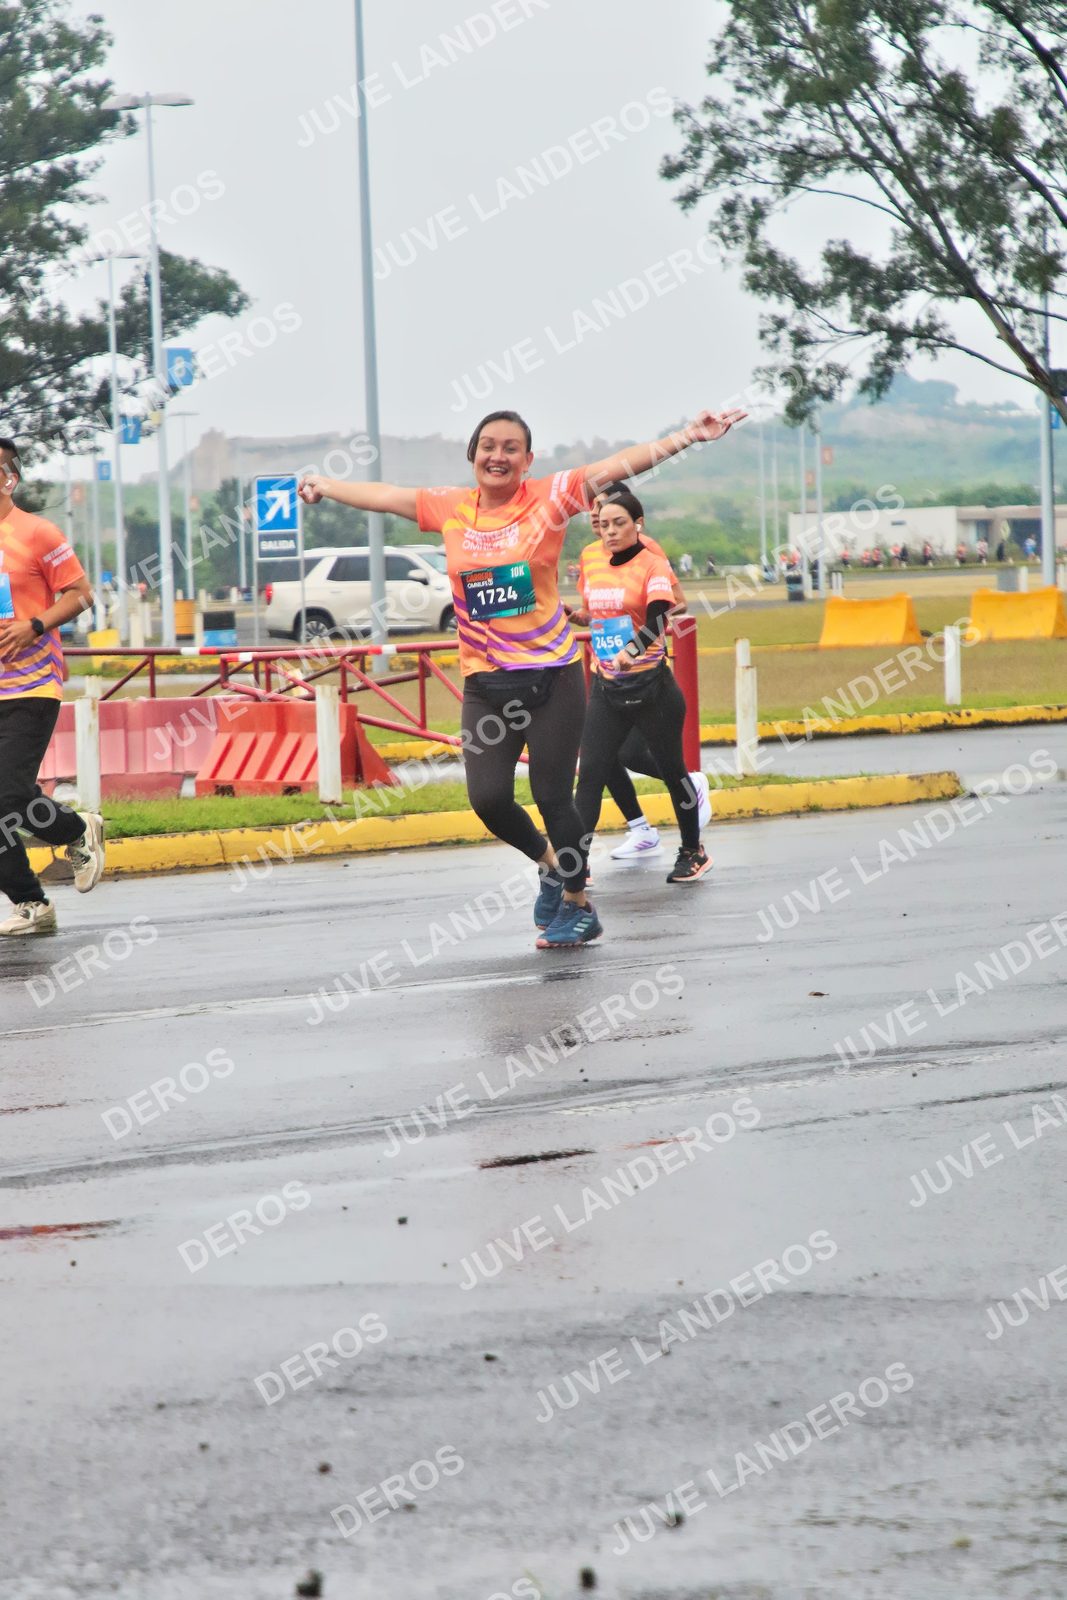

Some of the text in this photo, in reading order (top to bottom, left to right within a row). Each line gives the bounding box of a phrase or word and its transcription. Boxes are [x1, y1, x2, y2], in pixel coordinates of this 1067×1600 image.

[260, 540, 296, 550] SALIDA
[510, 565, 525, 578] 10K
[477, 586, 518, 605] 1724
[595, 634, 624, 649] 2456
